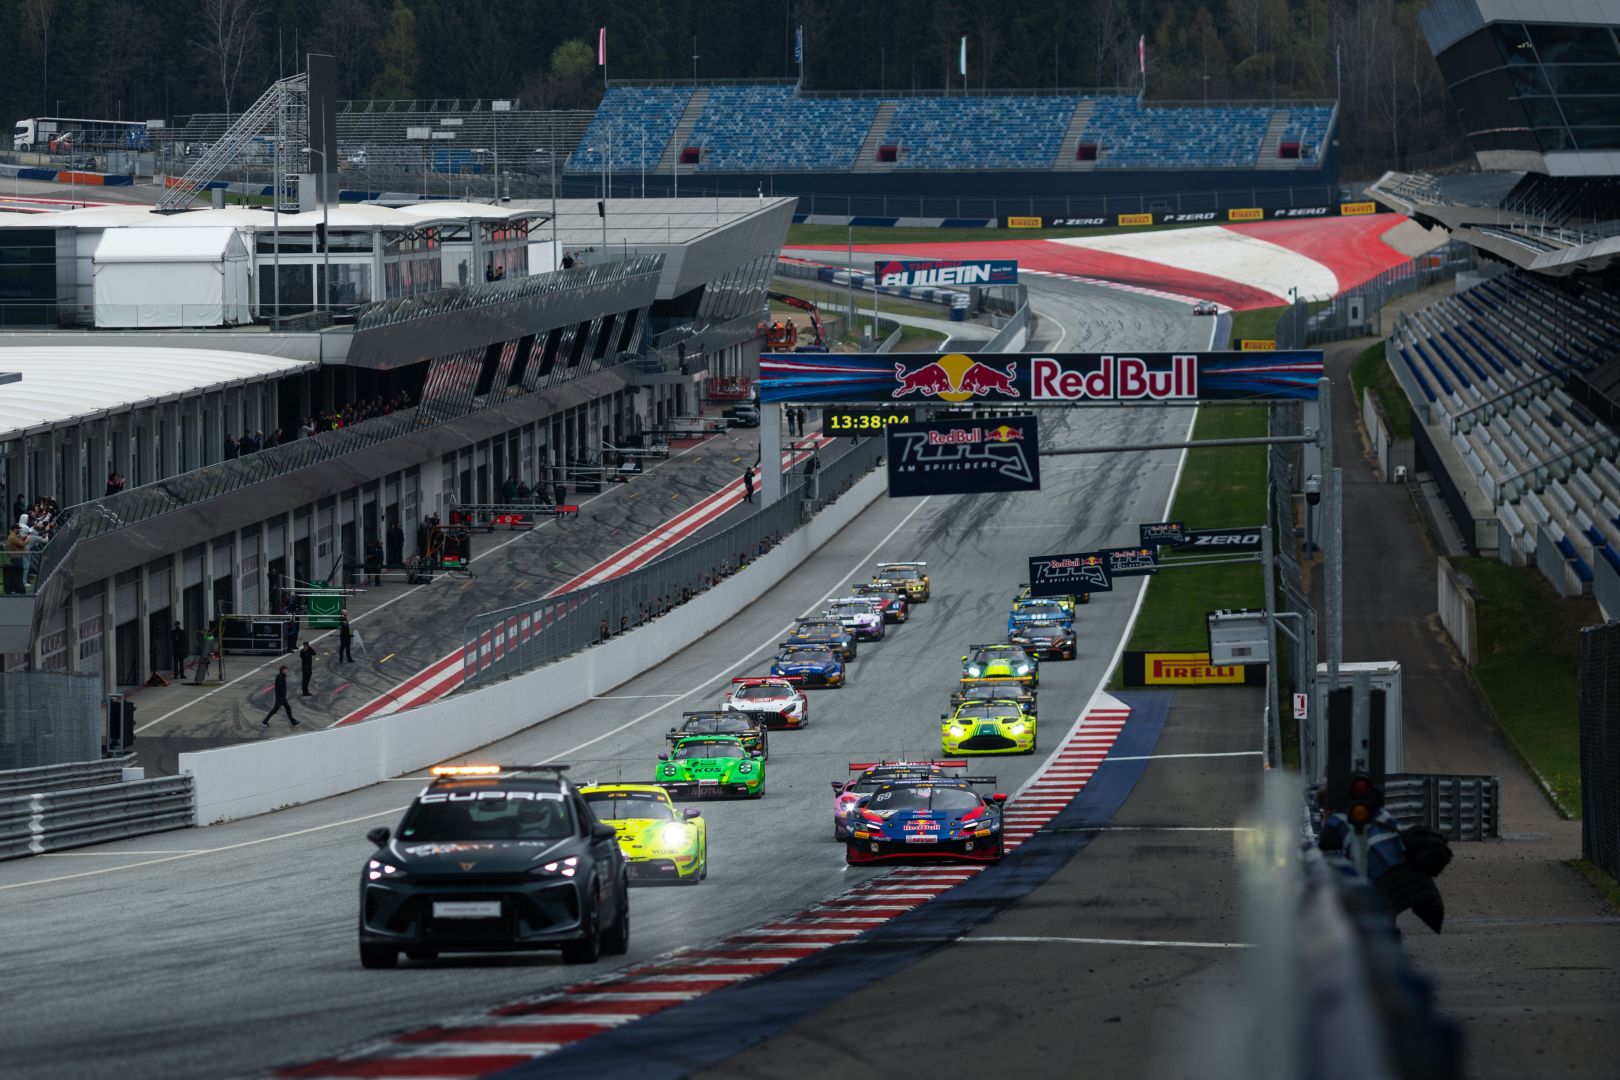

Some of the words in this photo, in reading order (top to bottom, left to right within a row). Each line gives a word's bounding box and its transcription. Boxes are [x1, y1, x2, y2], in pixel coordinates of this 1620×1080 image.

[1176, 212, 1216, 221] ZERO
[1287, 208, 1327, 216] ZERO
[1030, 355, 1114, 399] Red
[1117, 355, 1198, 399] Bull
[928, 429, 955, 445] Red
[956, 428, 981, 444] Bull
[898, 464, 916, 472] AM
[924, 461, 998, 472] SPIELBERG
[1194, 534, 1260, 545] ZERO
[1153, 660, 1235, 678] PIRELLI
[419, 791, 565, 804] CUPRA
[876, 791, 893, 802] 69
